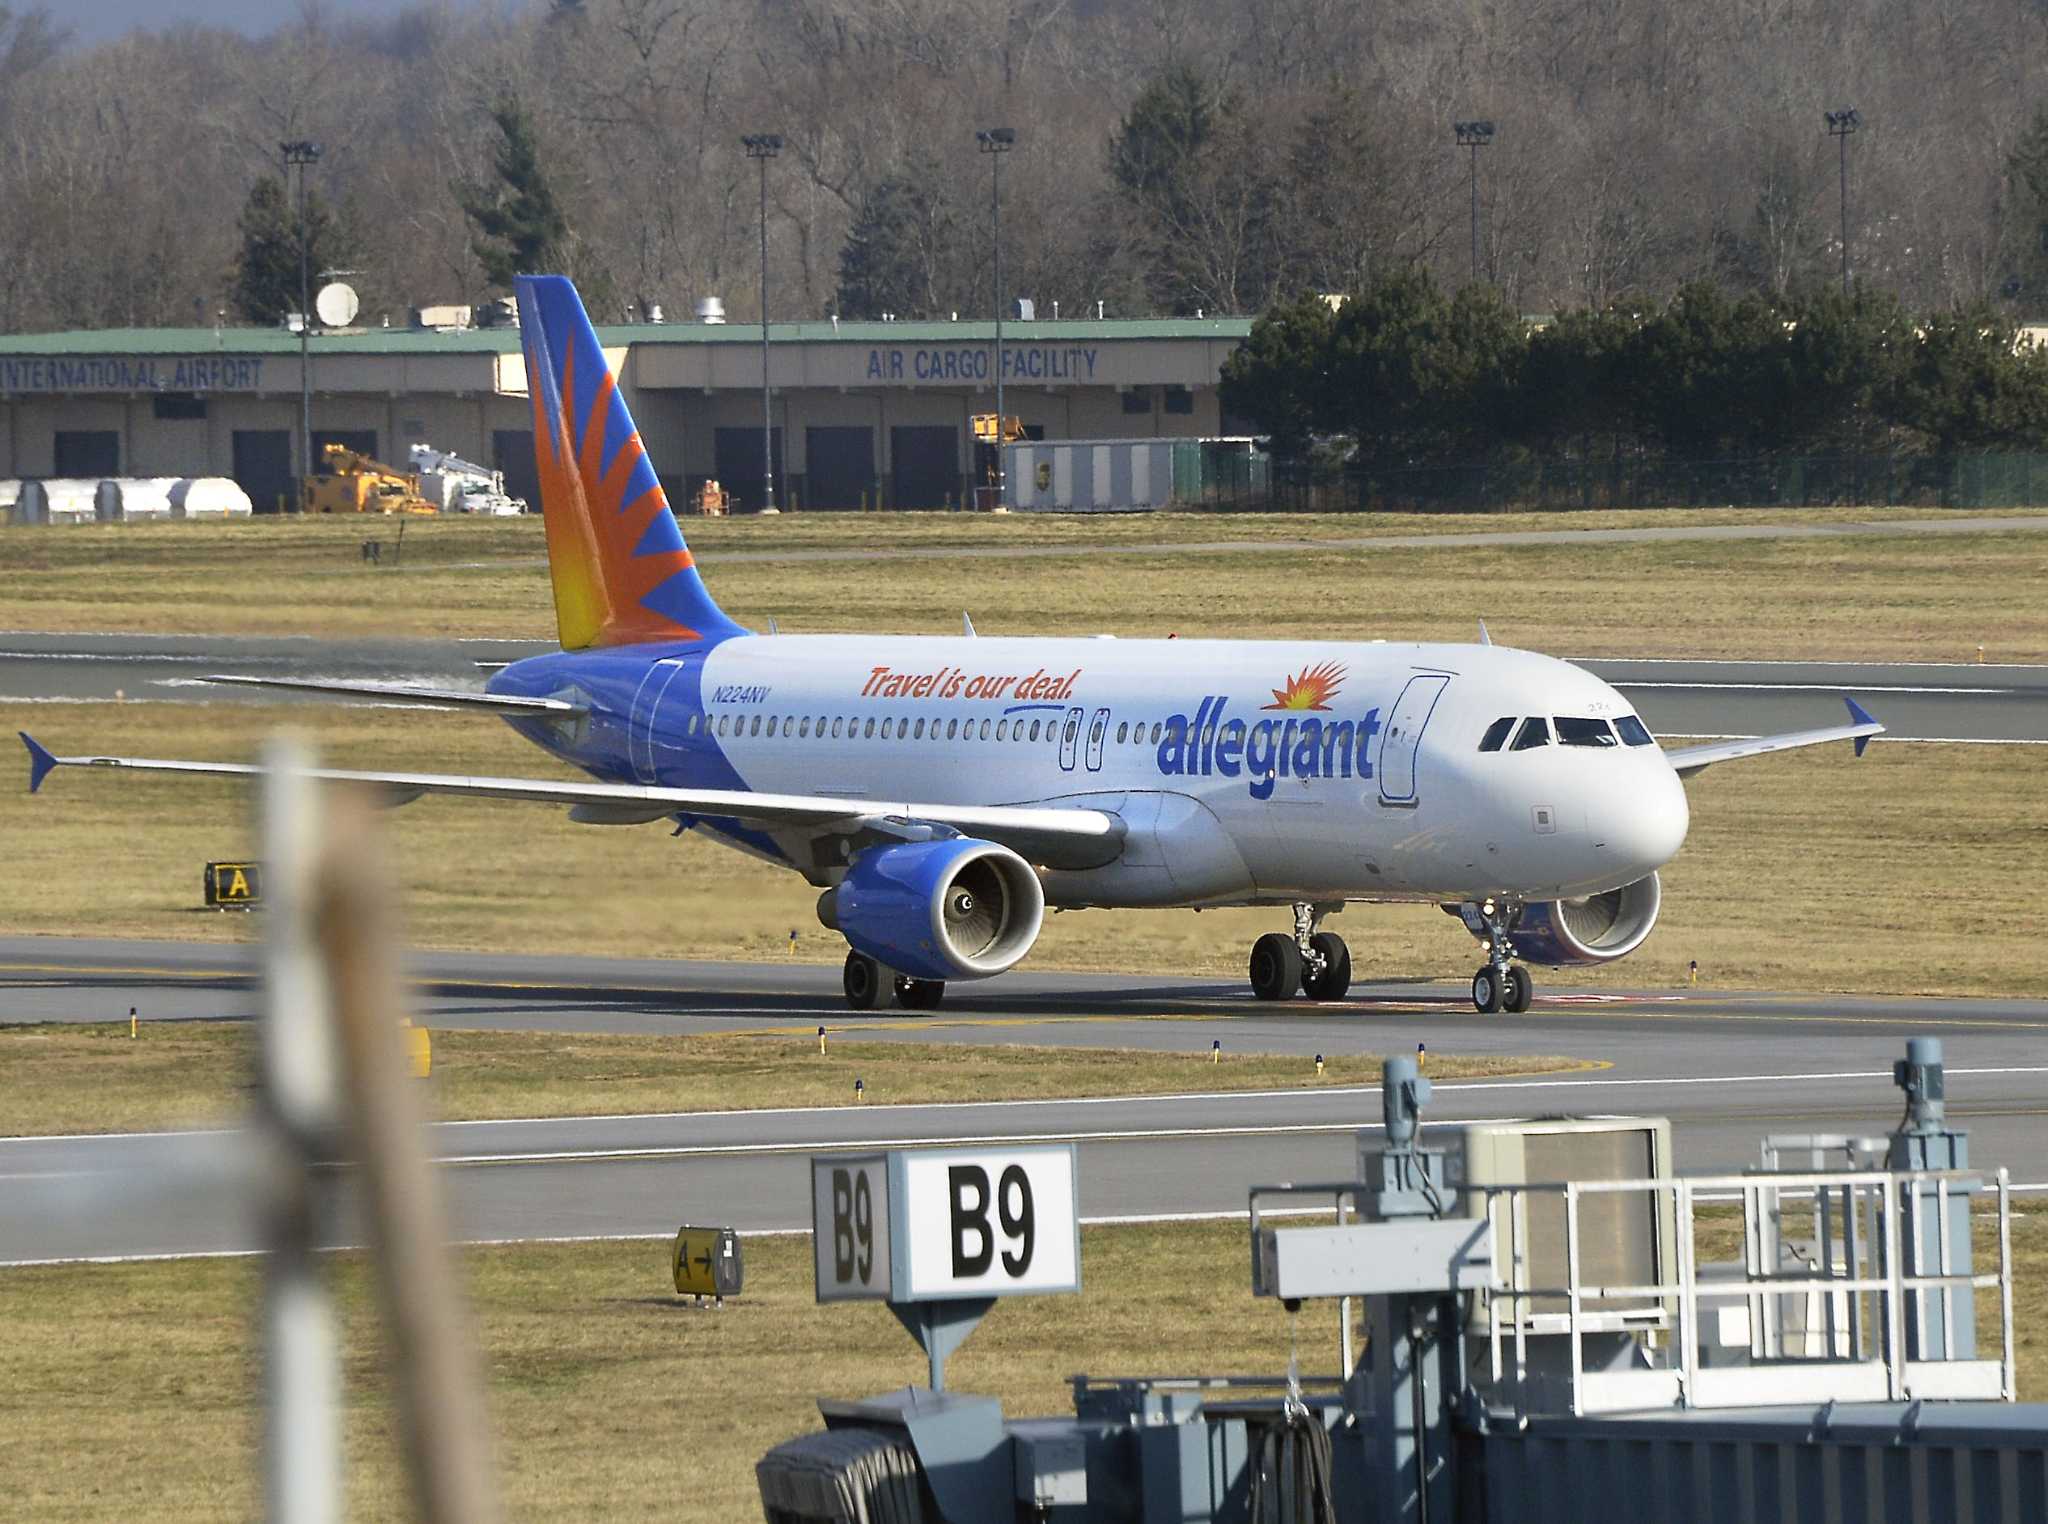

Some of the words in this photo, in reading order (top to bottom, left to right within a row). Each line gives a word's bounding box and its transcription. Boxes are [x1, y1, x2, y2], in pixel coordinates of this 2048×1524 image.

[175, 359, 263, 388] AIRPORT
[867, 350, 904, 379] AIR
[915, 350, 988, 378] CARGO
[1002, 349, 1097, 377] FACILITY
[711, 686, 772, 704] N224NV
[861, 667, 949, 698] Travel
[938, 668, 967, 698] is
[964, 675, 1018, 699] our
[1013, 668, 1083, 700] deal.
[1157, 695, 1381, 800] allegiant
[229, 869, 250, 896] A
[833, 1168, 873, 1286] B9
[949, 1163, 1036, 1279] B9
[675, 1239, 692, 1280] A
